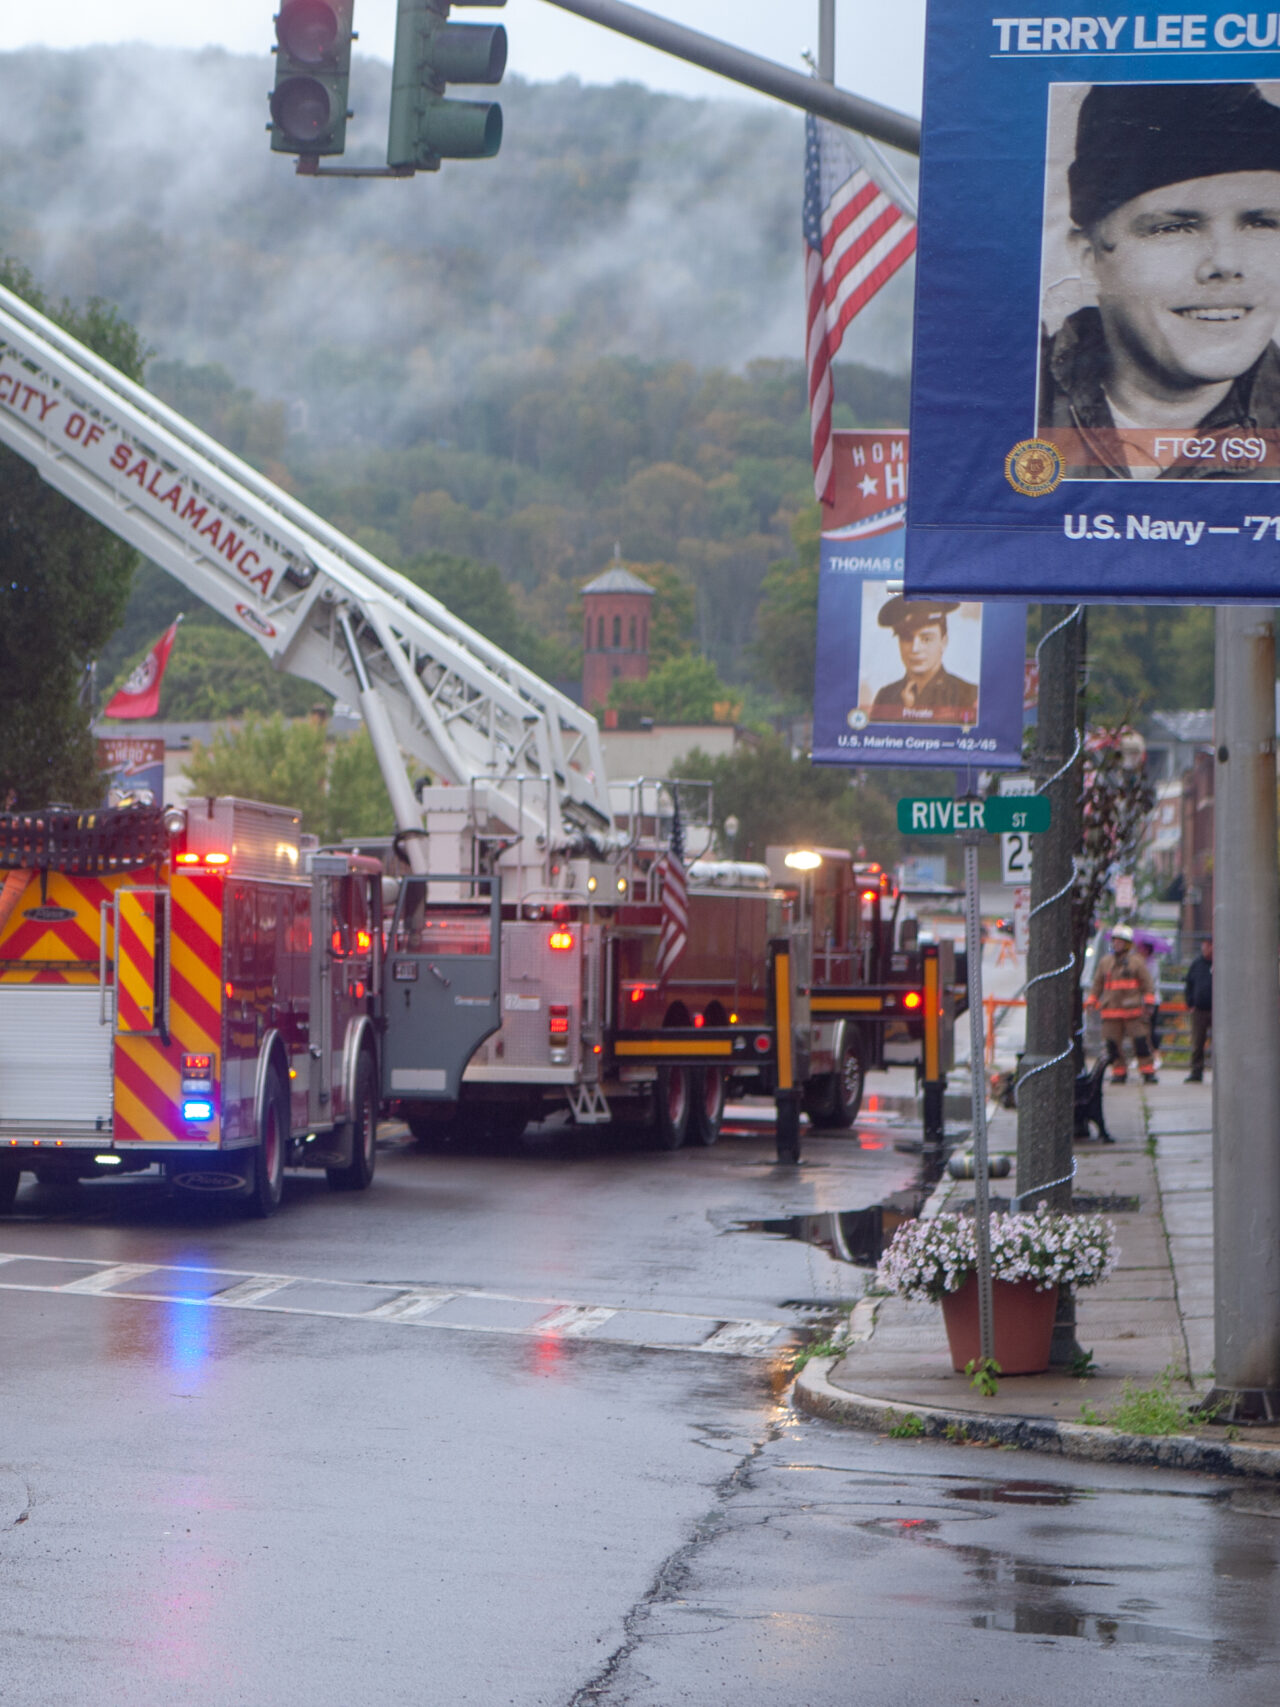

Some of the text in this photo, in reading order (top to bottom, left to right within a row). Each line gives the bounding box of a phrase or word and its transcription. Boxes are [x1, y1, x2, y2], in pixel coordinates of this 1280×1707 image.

[992, 13, 1280, 51] TERRY LEE CU
[852, 441, 904, 467] HOM
[1154, 437, 1267, 462] FTG2 (SS)
[885, 463, 908, 499] H
[64, 413, 106, 447] OF
[109, 443, 275, 595] SALAMANCA
[1064, 514, 1122, 540] U.S.
[1126, 514, 1206, 546] Navy
[830, 557, 891, 572] THOMAS
[903, 708, 934, 719] Private
[838, 735, 862, 748] U.S.
[863, 736, 903, 749] Marine
[905, 738, 941, 751] Corps
[912, 802, 1028, 829] RIVER ST
[1007, 835, 1032, 873] 2
